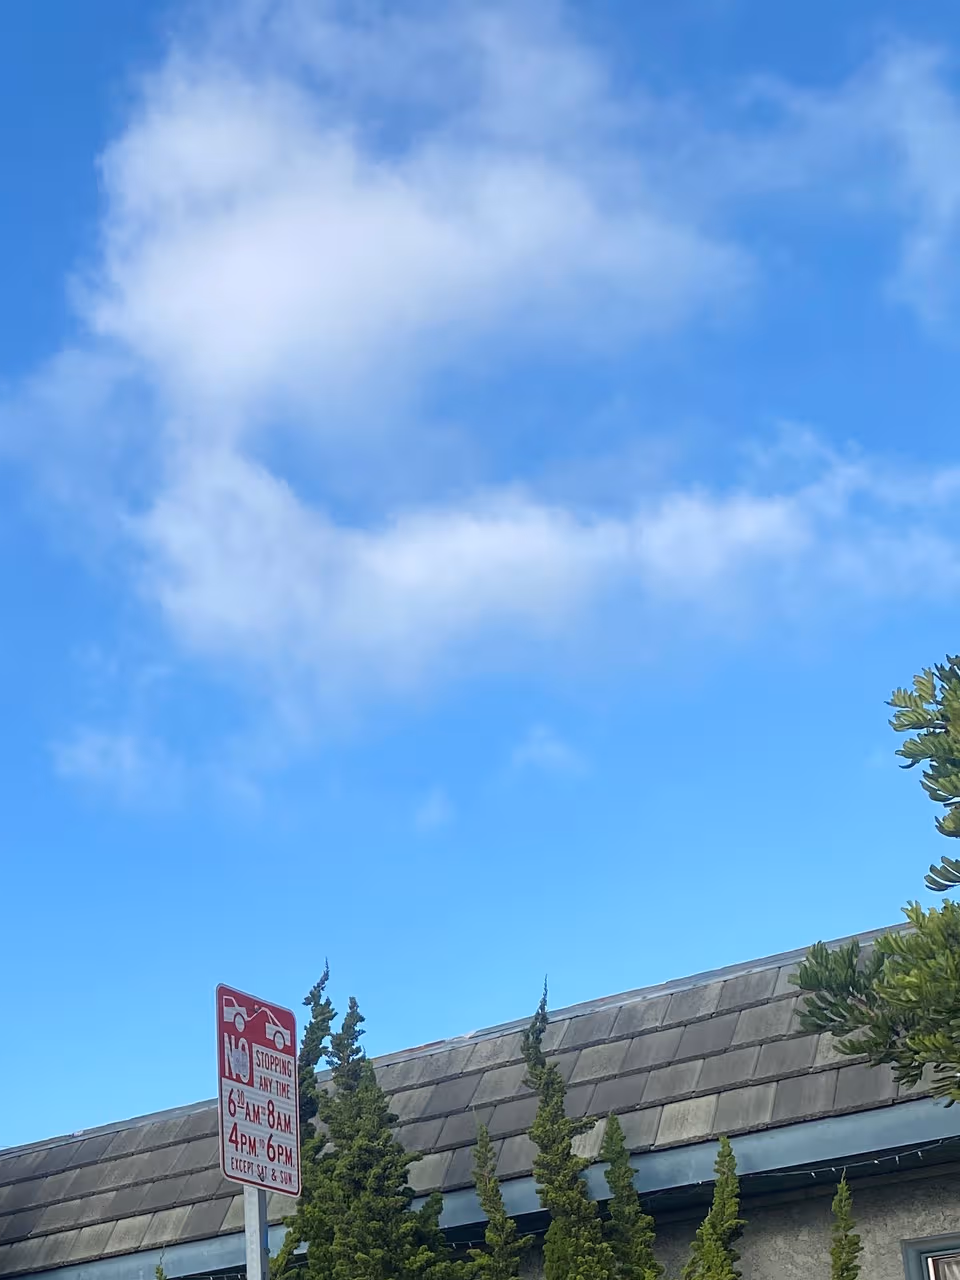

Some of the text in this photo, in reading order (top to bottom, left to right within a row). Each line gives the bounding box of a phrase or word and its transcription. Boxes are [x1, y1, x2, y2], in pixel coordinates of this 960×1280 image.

[224, 1032, 250, 1083] NO
[255, 1049, 292, 1078] STOPPING
[259, 1075, 291, 1100] ANY TIME
[230, 1156, 254, 1175] EXCEPT
[271, 1168, 277, 1181] &
